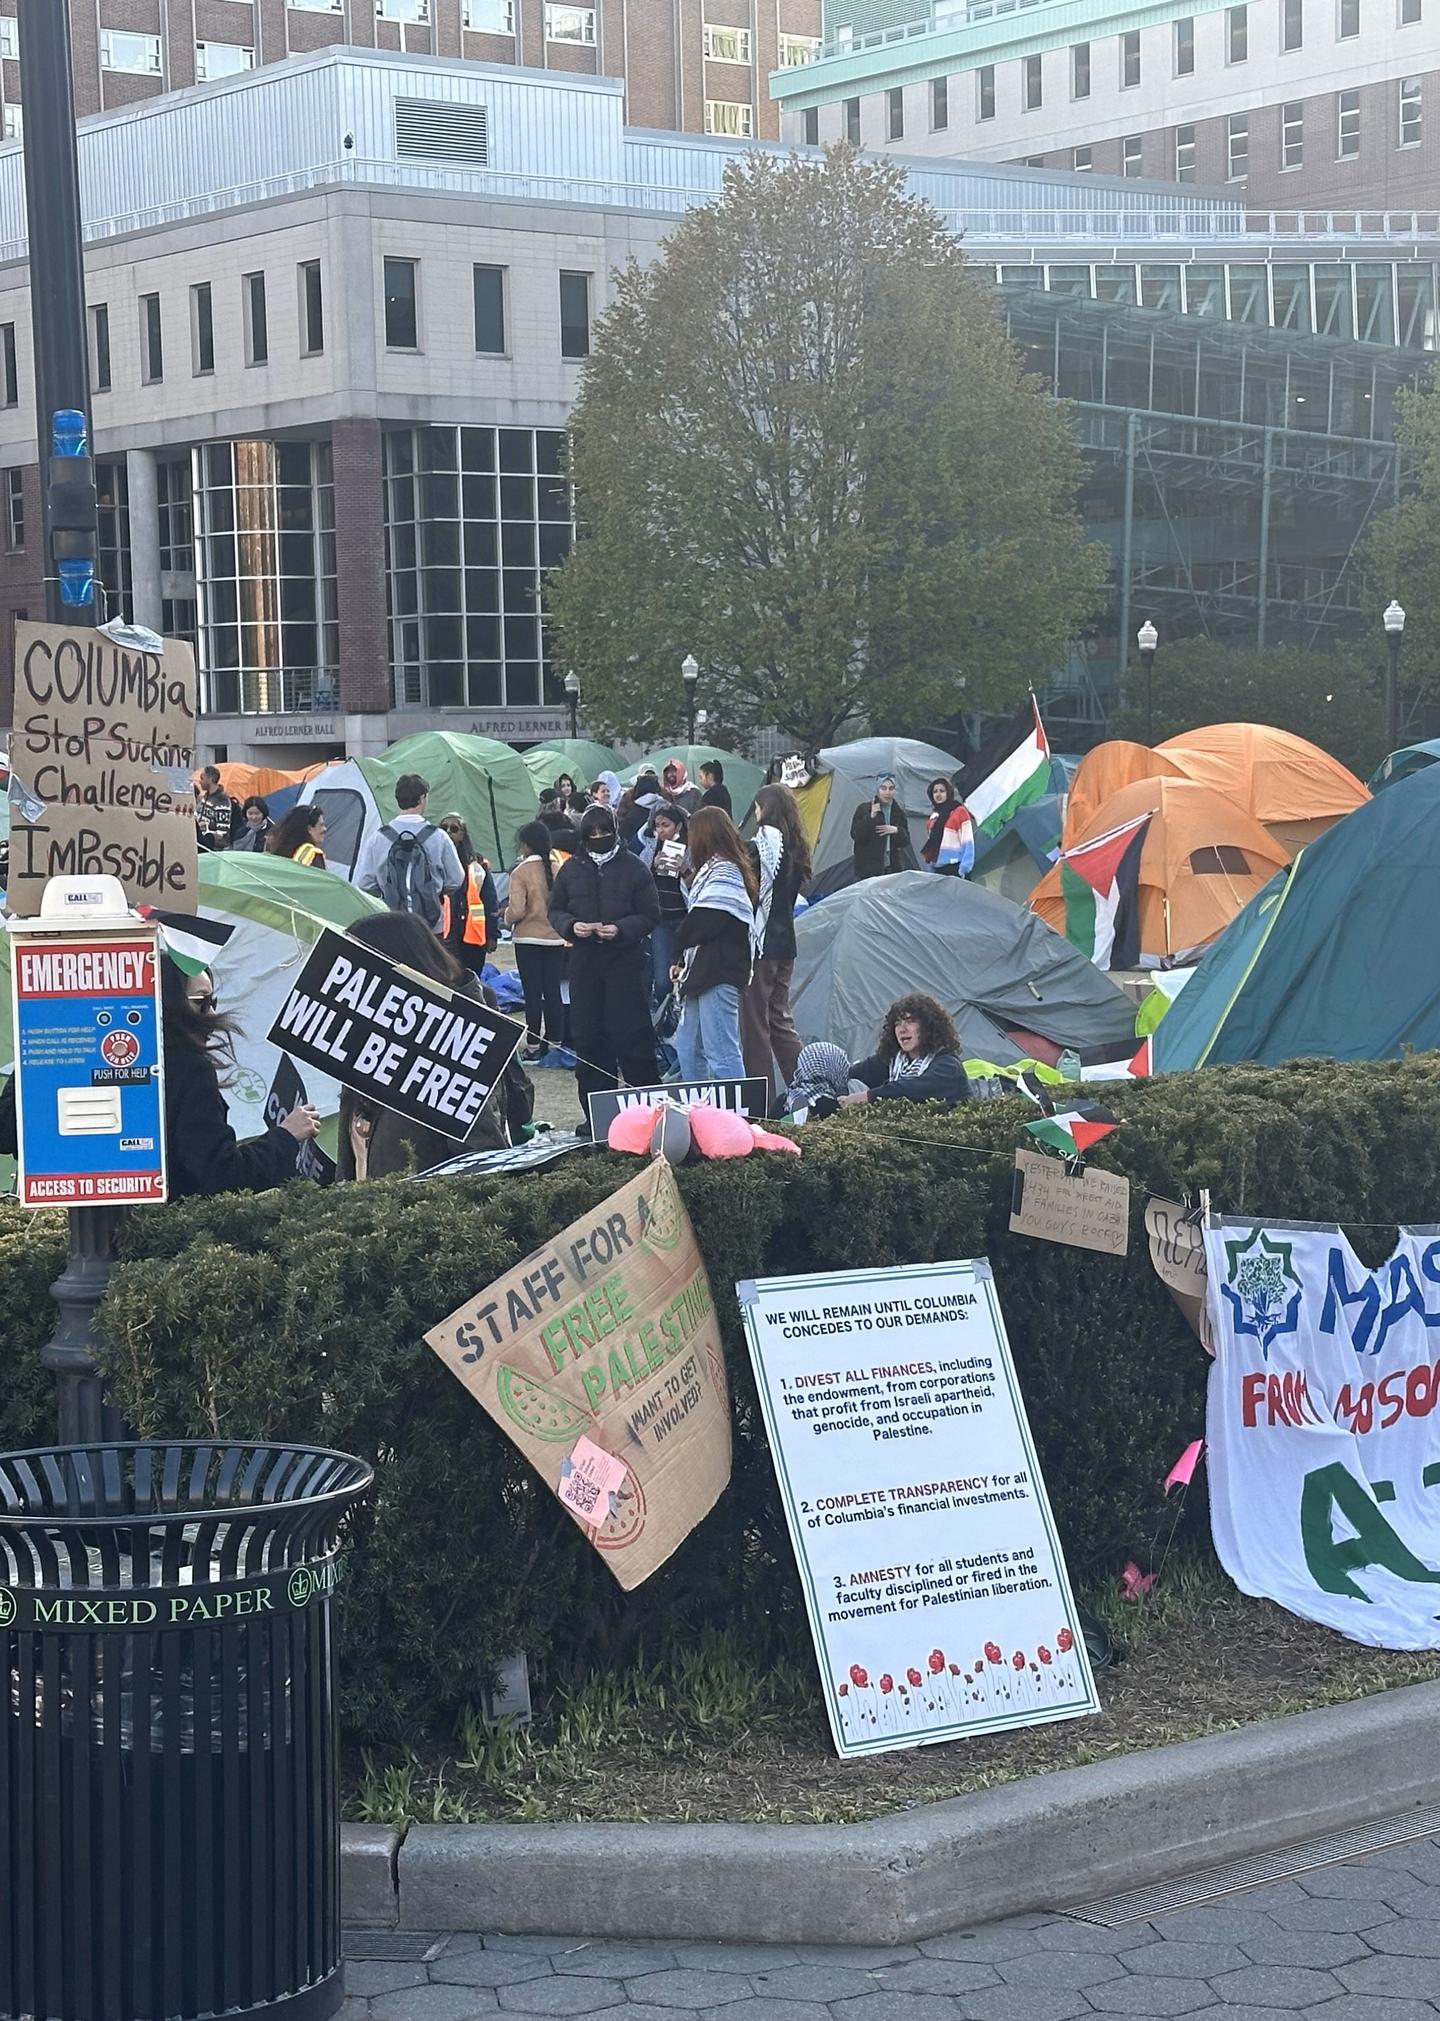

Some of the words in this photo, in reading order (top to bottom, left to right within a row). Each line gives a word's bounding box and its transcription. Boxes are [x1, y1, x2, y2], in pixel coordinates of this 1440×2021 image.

[255, 726, 284, 737] ALFRED
[284, 725, 314, 737] LERNER
[314, 724, 336, 735] HALL
[470, 721, 516, 733] ALFRED
[518, 720, 562, 732] LERNER
[21, 951, 146, 993] EMERGENCY
[320, 956, 496, 1070] PALESTINE
[94, 1069, 113, 1080] PUSH
[114, 1068, 129, 1079] FOR
[131, 1068, 148, 1079] HELP
[280, 989, 353, 1062] WILL
[353, 1032, 407, 1086] BE
[400, 1056, 489, 1124] FREE
[29, 1178, 75, 1197] ACCESS
[78, 1178, 94, 1196] TO
[95, 1176, 152, 1195] SECURITY
[455, 1258, 565, 1365] STAFF
[571, 1212, 635, 1281] FOR
[539, 1273, 635, 1376] FREE
[765, 1312, 786, 1326] WE
[789, 1308, 821, 1323] WILL
[823, 1303, 872, 1319] REMAIN
[874, 1299, 912, 1315] UNTIL
[914, 1293, 978, 1310] COLUMBIA
[782, 1321, 853, 1339] CONCEDES
[854, 1318, 873, 1331] TO
[876, 1315, 902, 1329] OUR
[906, 1309, 969, 1326] DEMANDS:
[580, 1268, 711, 1417] PALESTINE
[631, 1390, 664, 1432] WANT
[664, 1376, 680, 1399] TO
[680, 1354, 697, 1385] GET
[780, 1378, 793, 1390] 1.
[795, 1371, 841, 1389] DIVEST
[845, 1367, 869, 1382] ALL
[871, 1361, 938, 1379] FINANCES,
[938, 1357, 993, 1373] including
[783, 1394, 804, 1406] the
[808, 1384, 885, 1403] endowment,
[886, 1379, 917, 1393] from
[919, 1371, 996, 1390] corporations
[653, 1380, 702, 1443] INVOLVED?
[792, 1405, 819, 1420] that
[822, 1400, 857, 1418] profit
[860, 1397, 892, 1412] from
[894, 1393, 932, 1407] Israeli
[934, 1386, 995, 1405] apartheid,
[813, 1417, 874, 1435] genocide,
[876, 1411, 900, 1425] and
[902, 1404, 970, 1422] occupation
[971, 1402, 983, 1414] in
[873, 1425, 933, 1441] Palestine.
[800, 1502, 814, 1514] 2.
[816, 1490, 887, 1511] COMPLETE
[888, 1477, 988, 1501] TRANSPARENCY
[991, 1475, 1011, 1488] for
[1013, 1472, 1028, 1484] all
[807, 1517, 821, 1529] of
[824, 1506, 895, 1526] Columbia's
[897, 1497, 951, 1515] financial
[952, 1487, 1029, 1508] investments.
[833, 1576, 846, 1588] 3.
[849, 1565, 911, 1587] AMNESTY
[914, 1563, 934, 1576] for
[938, 1559, 953, 1573] all
[955, 1552, 1009, 1570] students
[1012, 1547, 1034, 1560] and
[836, 1587, 882, 1605] faculty
[885, 1576, 953, 1598] disciplined
[955, 1575, 969, 1586] or
[971, 1567, 1002, 1583] fired
[1003, 1566, 1016, 1578] in
[1018, 1563, 1038, 1576] the
[33, 1599, 157, 1624] MIXED
[168, 1588, 275, 1623] PAPER
[828, 1600, 897, 1622] movement
[899, 1598, 919, 1611] for
[922, 1586, 990, 1607] Palestinian
[991, 1577, 1053, 1596] liberation.
